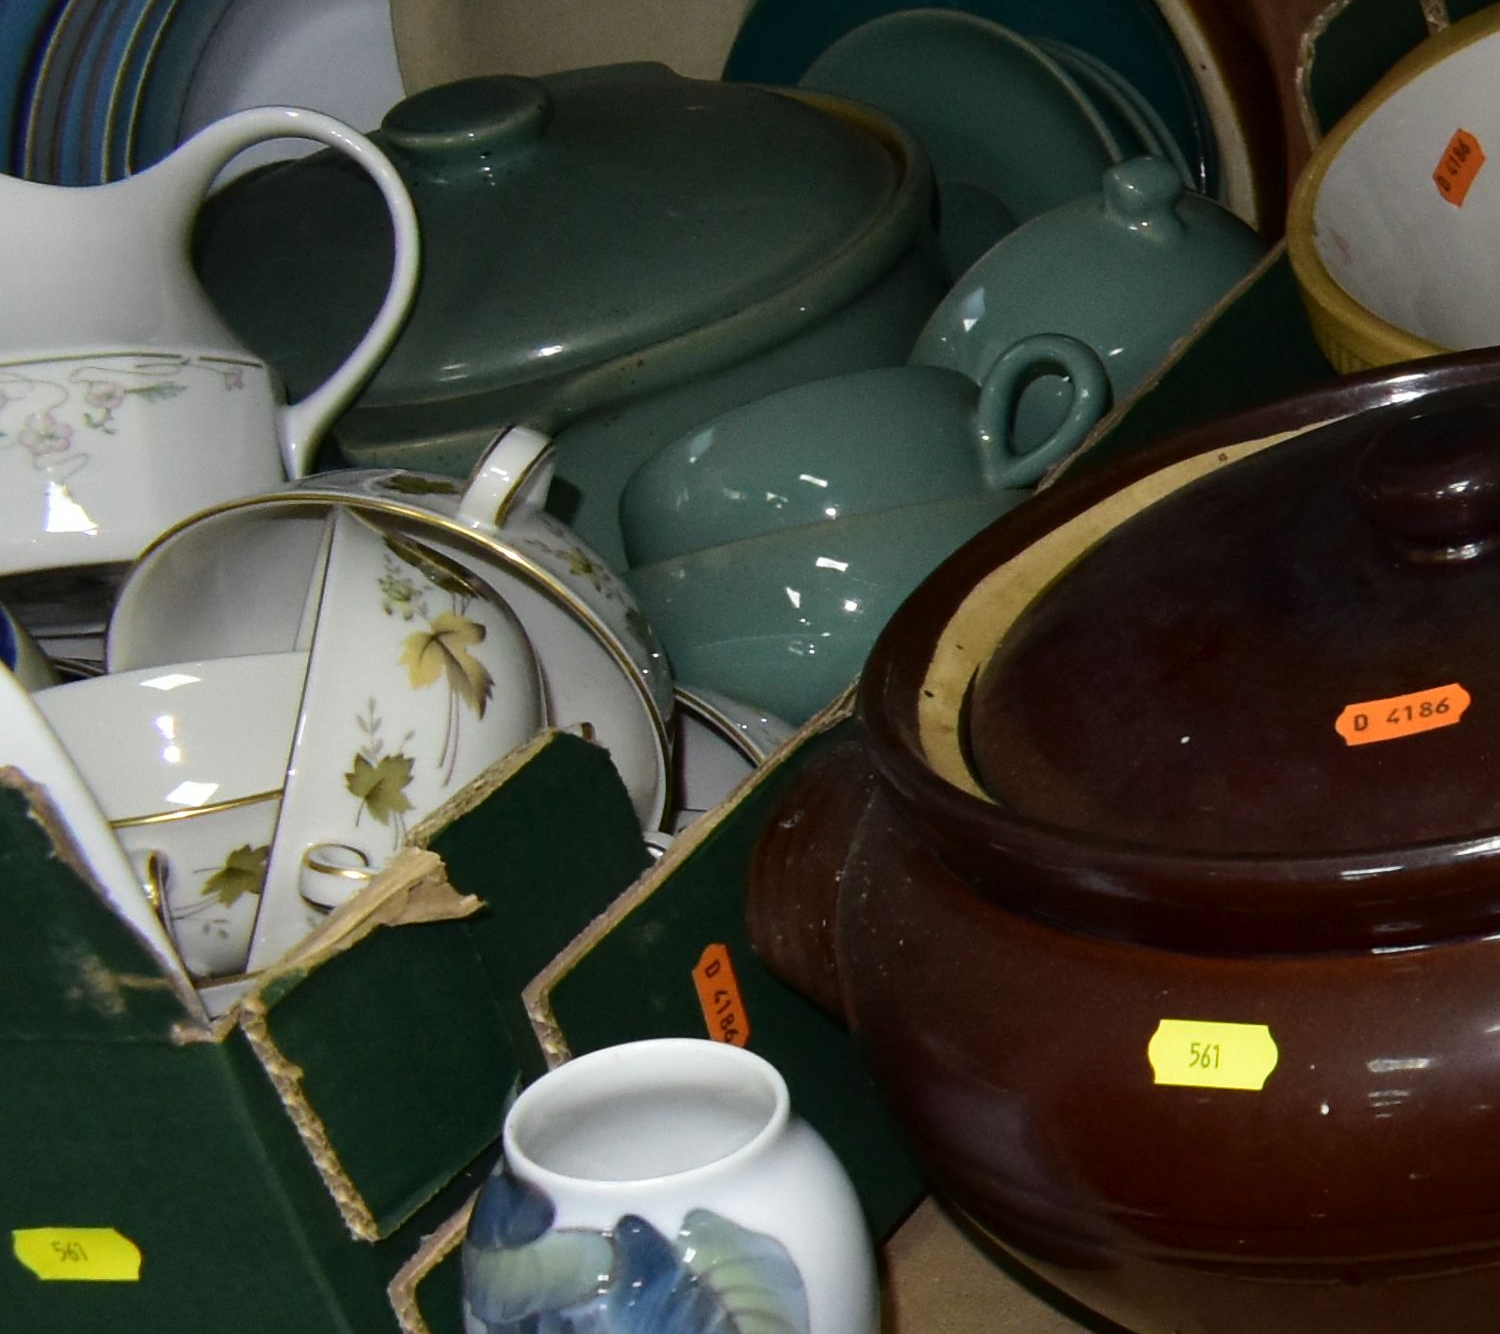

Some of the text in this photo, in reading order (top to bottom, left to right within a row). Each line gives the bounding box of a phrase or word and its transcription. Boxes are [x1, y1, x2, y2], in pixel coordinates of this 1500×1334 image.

[1353, 696, 1450, 732] D 4186
[704, 958, 721, 978] D
[1188, 1042, 1221, 1069] 561
[51, 1240, 89, 1263] 561
